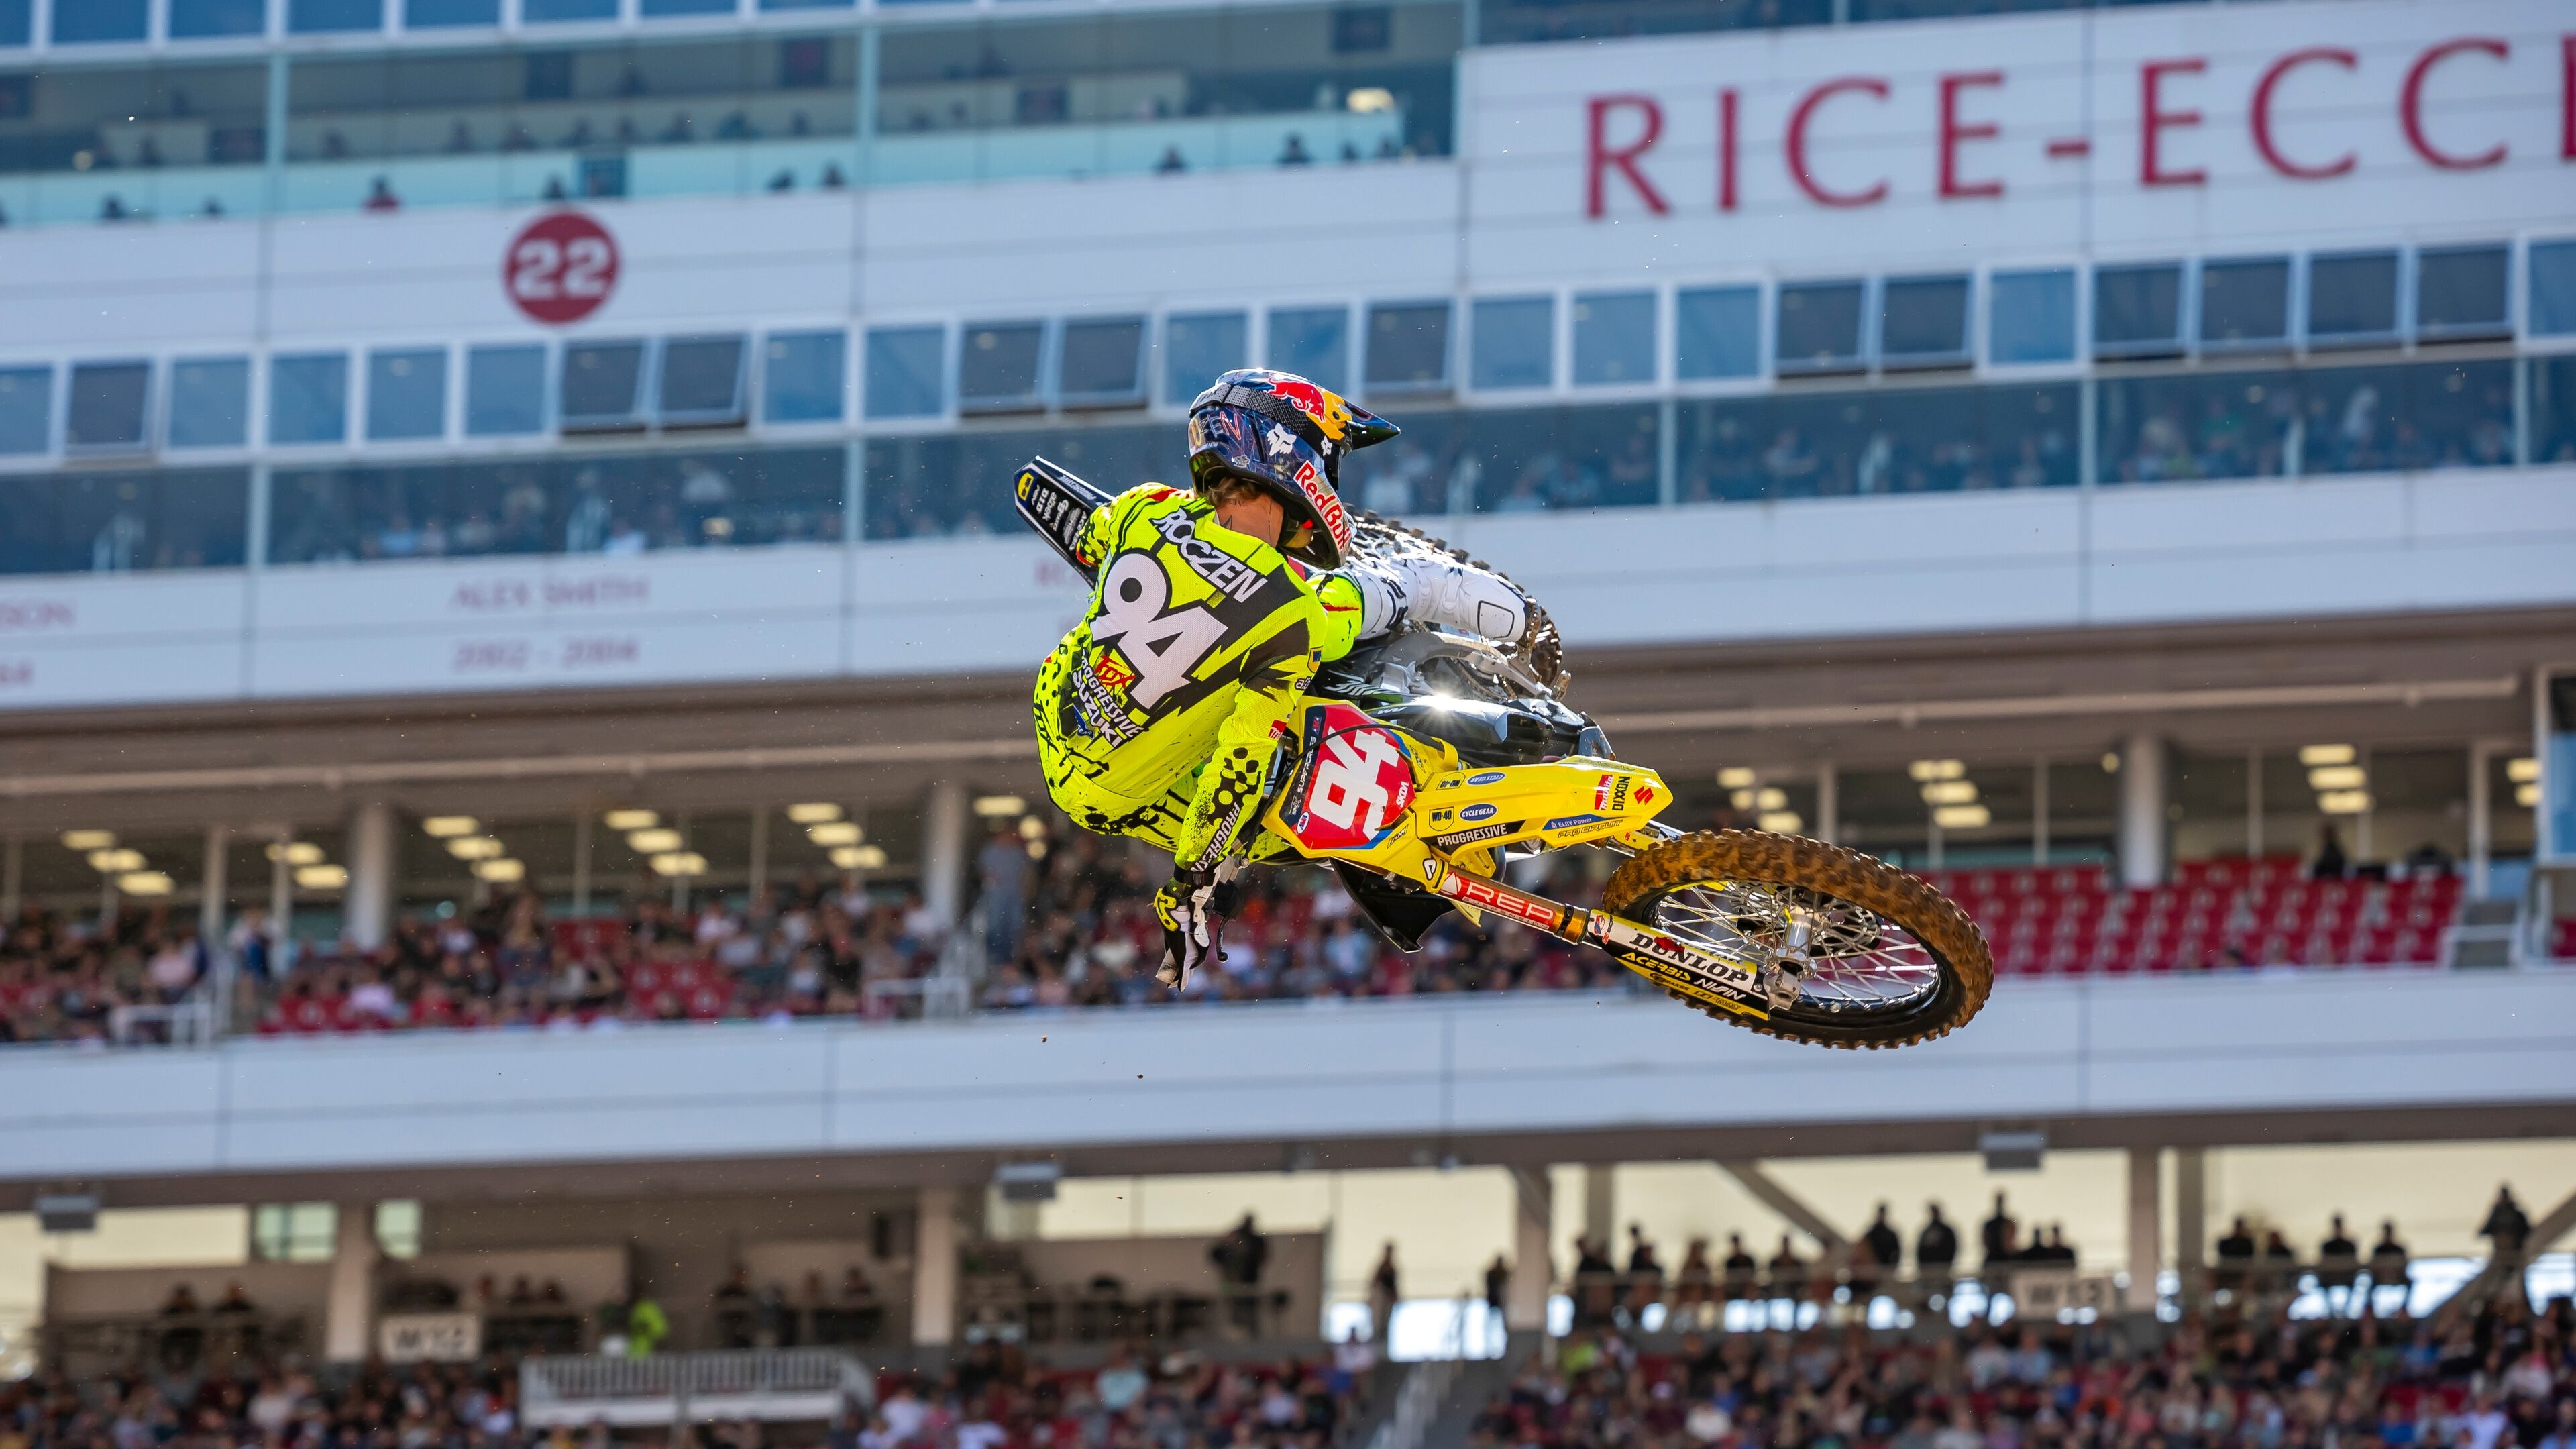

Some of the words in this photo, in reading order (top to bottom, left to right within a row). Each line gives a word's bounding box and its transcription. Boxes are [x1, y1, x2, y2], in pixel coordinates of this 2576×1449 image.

[1586, 34, 2576, 219] RICE-ECC
[514, 237, 609, 299] 22
[1293, 461, 1336, 513] Red
[1324, 504, 1352, 551] Bull
[1152, 508, 1268, 603] ROCZEN
[1090, 553, 1229, 710] 94
[1095, 654, 1136, 689] FOX
[1073, 669, 1123, 747] SUZUKI
[1309, 726, 1400, 841] 94
[1612, 776, 1631, 811] DIXXON
[1432, 810, 1452, 822] WD-40
[1462, 810, 1479, 818] CYCLE
[1478, 808, 1495, 816] GEAR
[1557, 828, 1581, 839] PRO
[1581, 820, 1623, 835] CIRCUIT
[1574, 817, 1593, 826] Power
[1437, 824, 1508, 847] PROGRESSIVE
[1462, 896, 1550, 930] SUSPENSION
[1466, 882, 1554, 920] REP
[1621, 952, 1691, 981] ACERBIS
[1694, 979, 1746, 1000] NISSIN
[1629, 933, 1750, 983] DUNLOP
